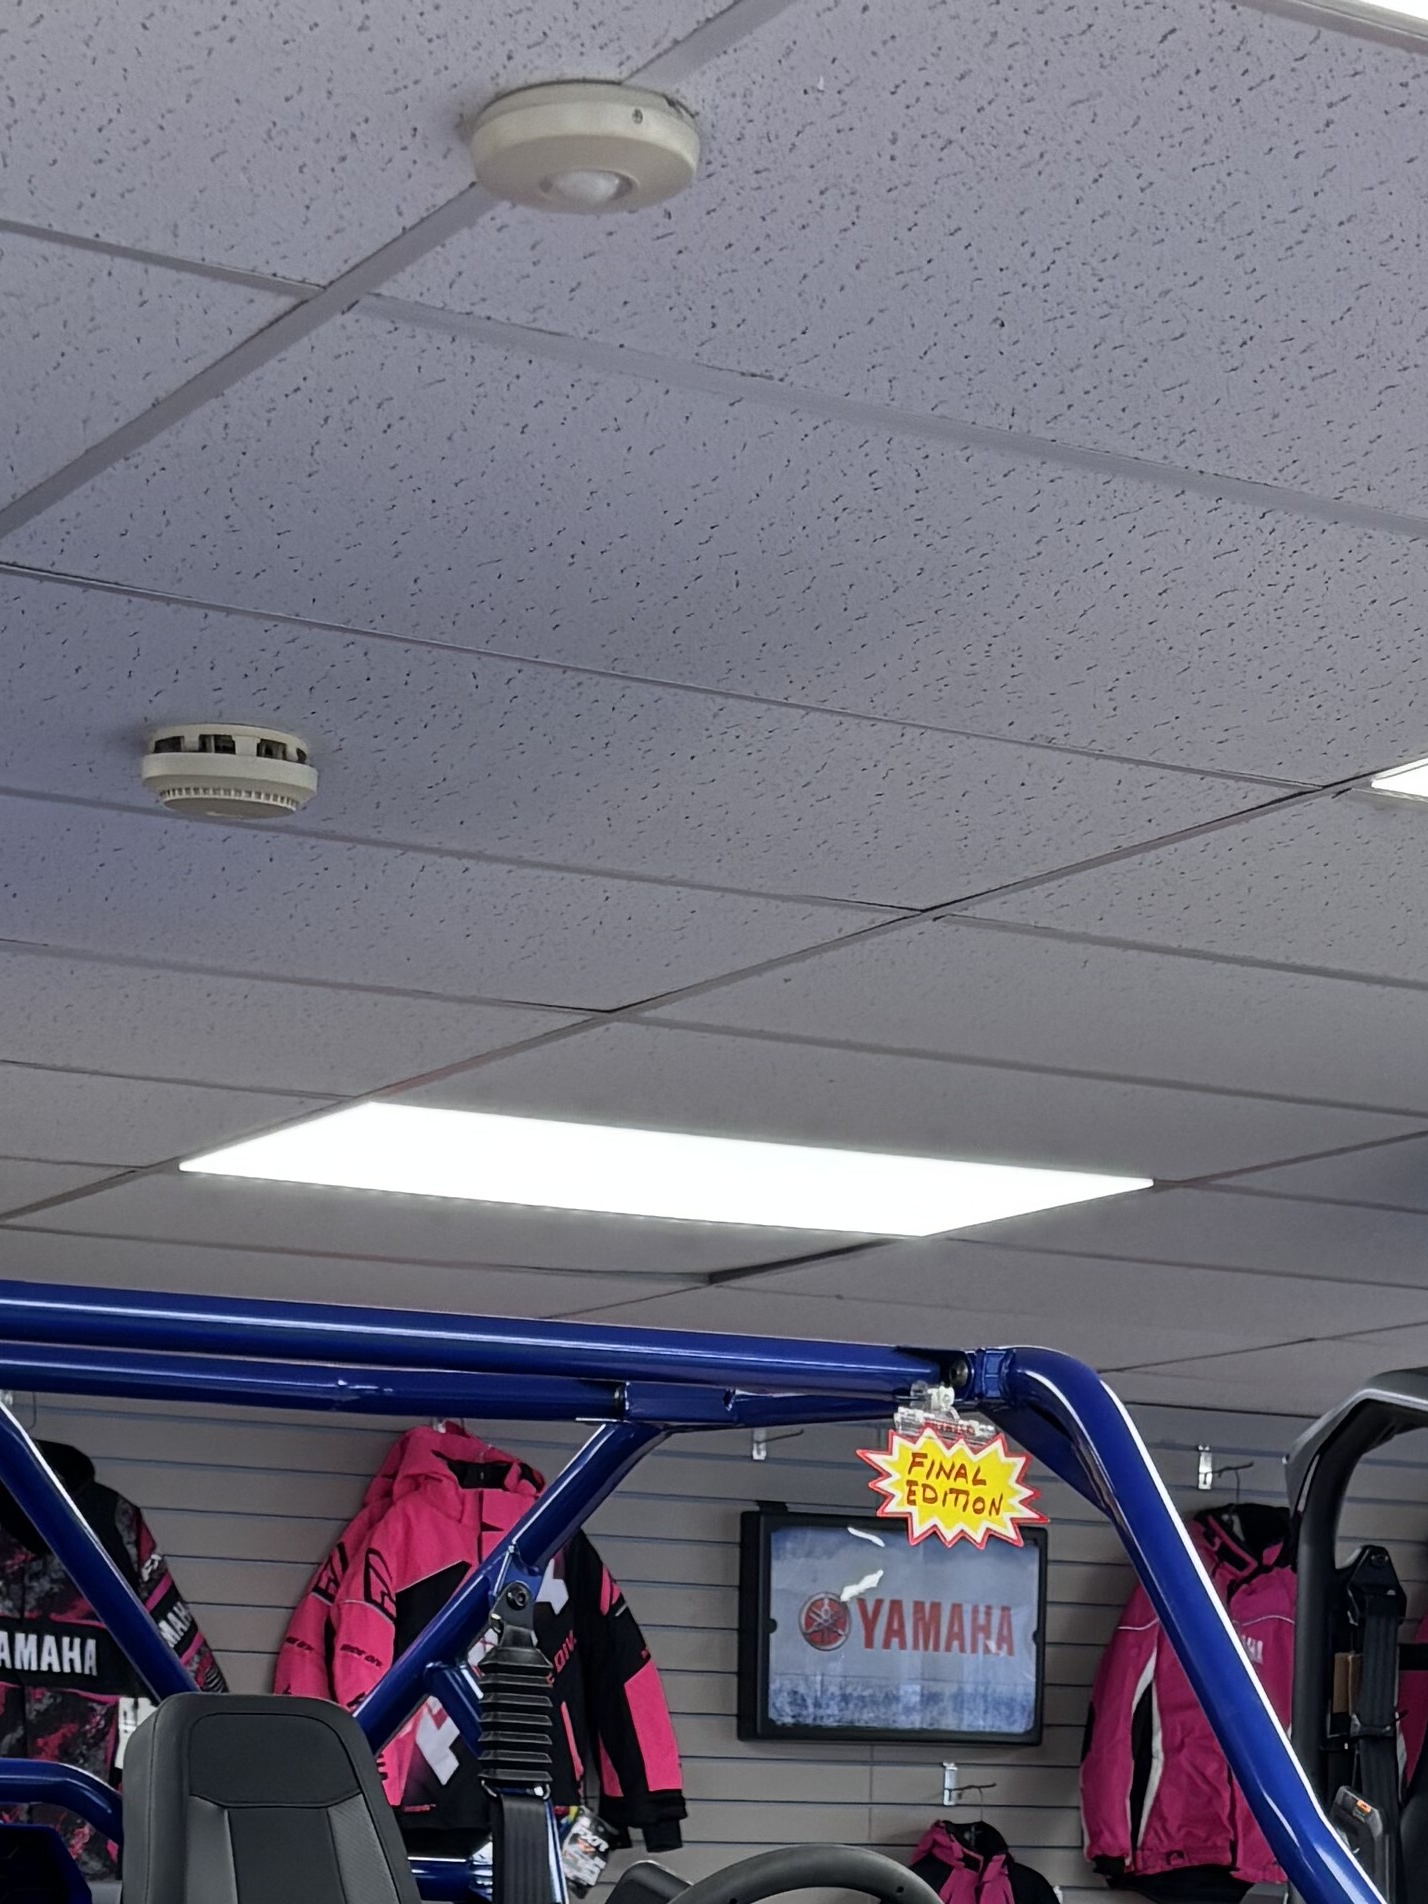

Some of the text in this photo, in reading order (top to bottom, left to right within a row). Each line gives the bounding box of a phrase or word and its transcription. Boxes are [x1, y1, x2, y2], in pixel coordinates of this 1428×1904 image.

[907, 1452, 987, 1486] FINAL
[905, 1479, 1004, 1517] EDITION
[856, 1597, 1015, 1657] YAMAHA
